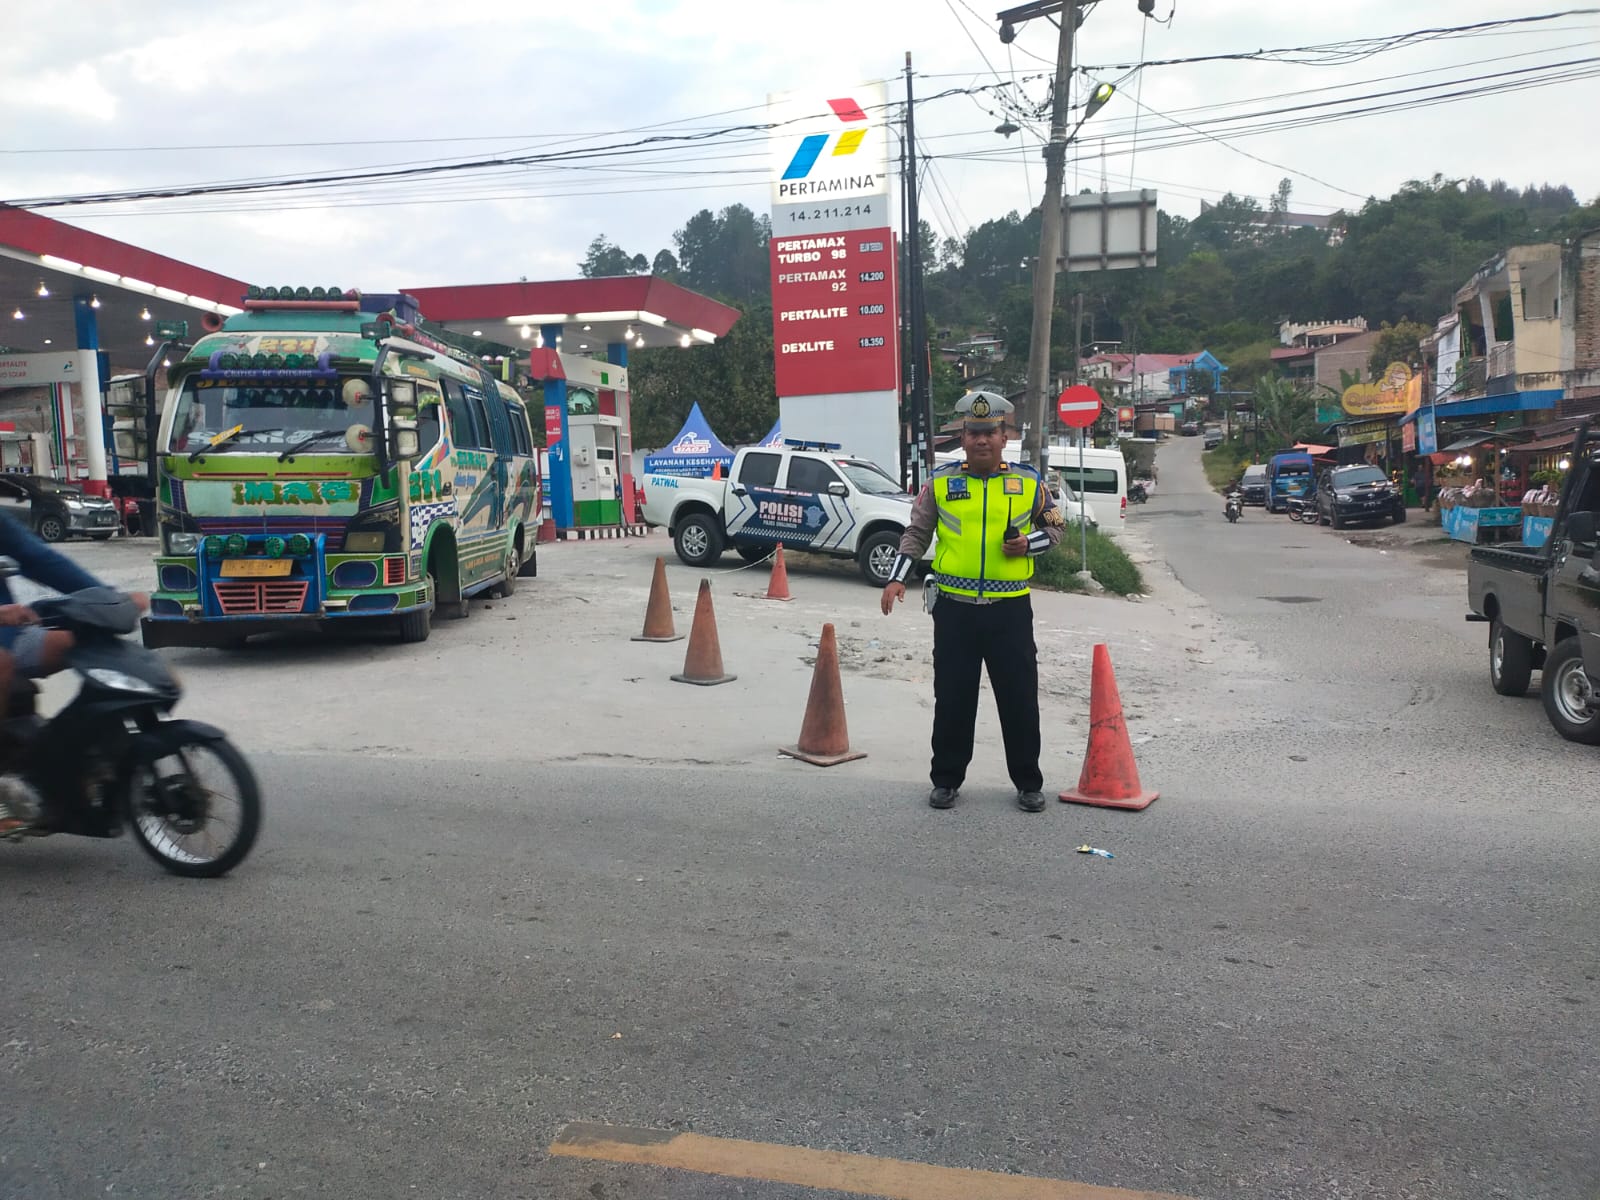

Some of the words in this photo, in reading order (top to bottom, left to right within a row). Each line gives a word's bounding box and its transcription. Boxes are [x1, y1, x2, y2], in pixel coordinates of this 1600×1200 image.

[779, 174, 875, 197] PERTAMINA
[790, 204, 872, 222] 14.211.214
[777, 236, 846, 252] PERTAMAX
[778, 251, 822, 264] TURBO
[831, 249, 847, 259] 98
[778, 269, 846, 283] PERTAMAX
[831, 282, 848, 292] 92
[780, 307, 848, 321] PERTALITE
[860, 304, 884, 315] 10.000
[782, 340, 835, 353] DEXLITE
[649, 458, 685, 467] LAYANAN
[686, 458, 731, 466] KESEHATAN
[651, 477, 679, 488] PATWAL
[760, 501, 804, 518] POLISI
[777, 516, 802, 524] LINTAS
